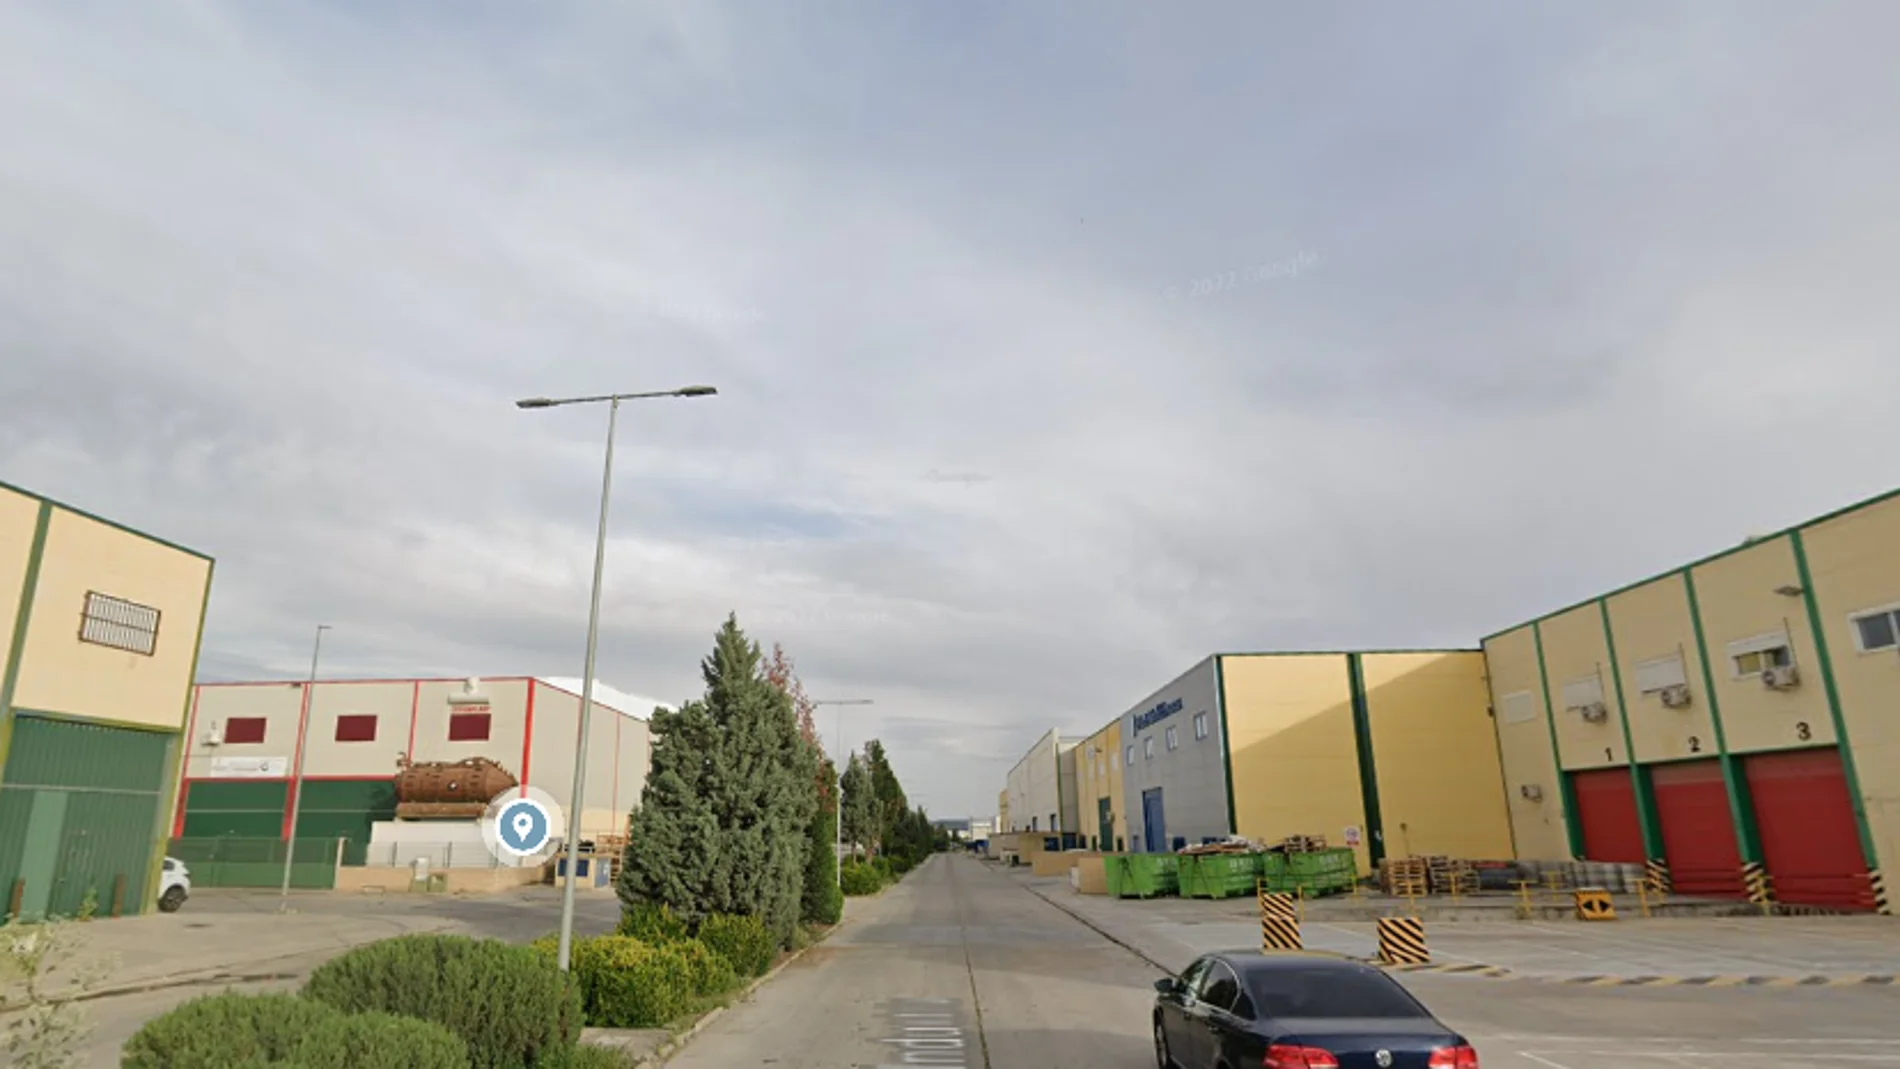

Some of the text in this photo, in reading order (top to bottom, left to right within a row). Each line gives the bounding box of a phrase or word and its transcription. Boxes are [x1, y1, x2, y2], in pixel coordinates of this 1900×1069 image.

[1796, 721, 1812, 741] 3
[1688, 736, 1701, 752] 2
[1605, 747, 1614, 762] 1
